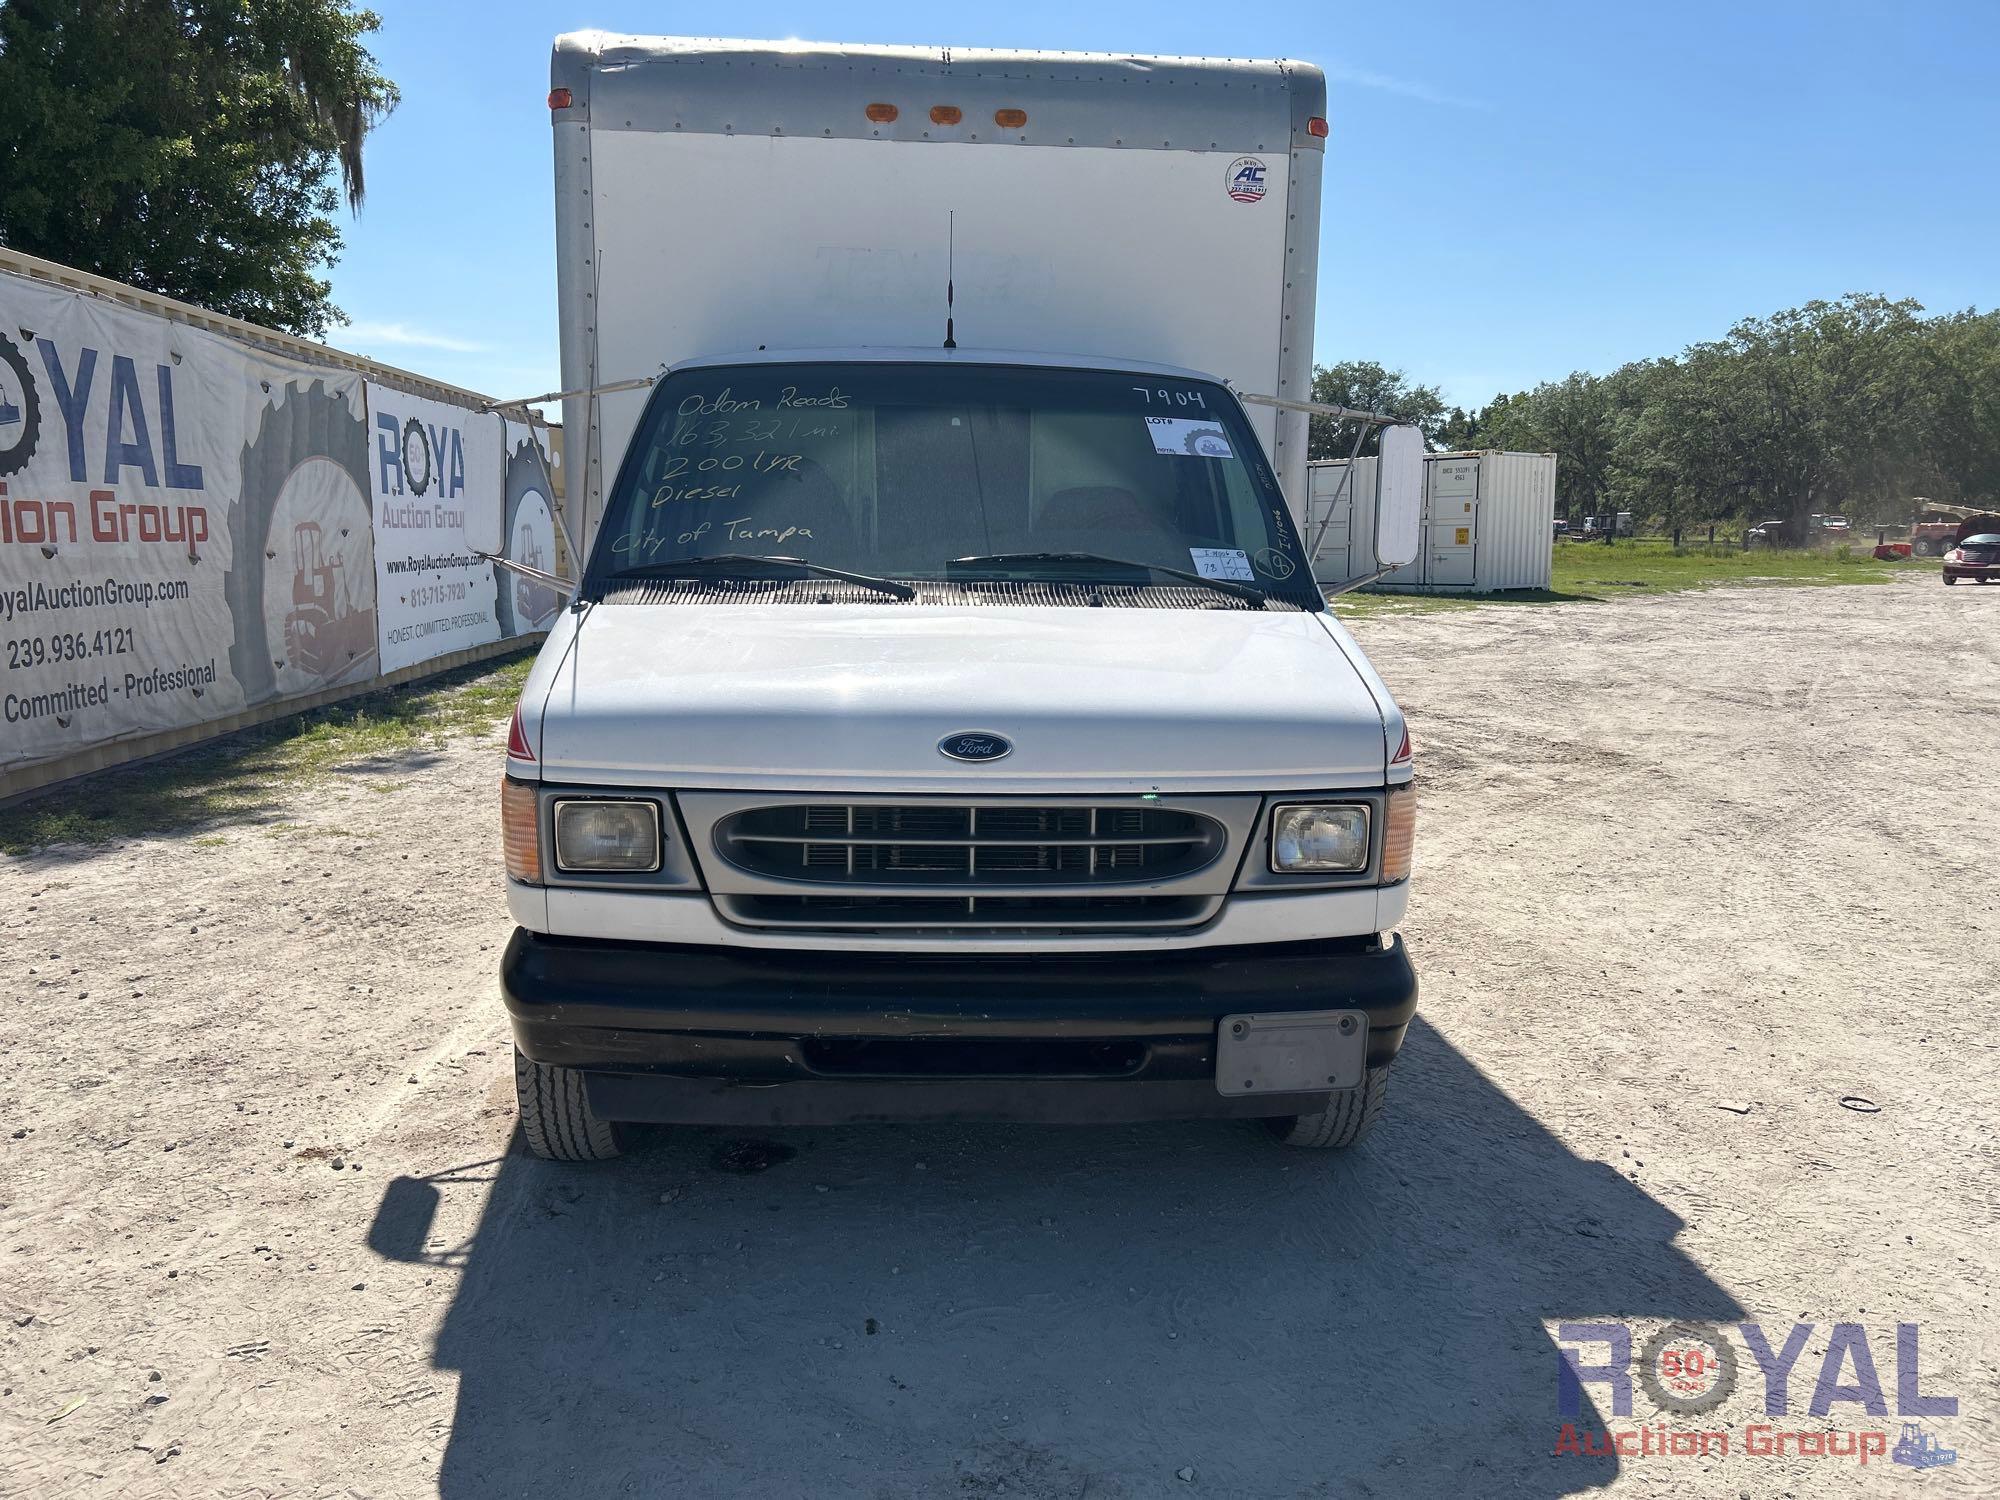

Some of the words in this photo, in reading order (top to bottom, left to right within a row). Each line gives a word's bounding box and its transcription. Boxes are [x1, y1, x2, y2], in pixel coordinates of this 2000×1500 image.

[1233, 166, 1267, 182] AC
[678, 387, 760, 416] Odom
[777, 386, 852, 411] Reads
[1132, 387, 1206, 409] 7904
[1146, 417, 1173, 425] LOT#
[652, 484, 741, 508] Diesel
[90, 490, 209, 552] Group
[382, 501, 431, 529] Auction
[611, 529, 666, 556] City
[677, 522, 711, 544] of
[723, 517, 813, 544] Tampa
[411, 582, 466, 608] 813-715-7920
[7, 627, 134, 670] 239.936.4121
[4, 676, 109, 723] Committed
[125, 658, 216, 699] Professional
[957, 738, 994, 754] Ford
